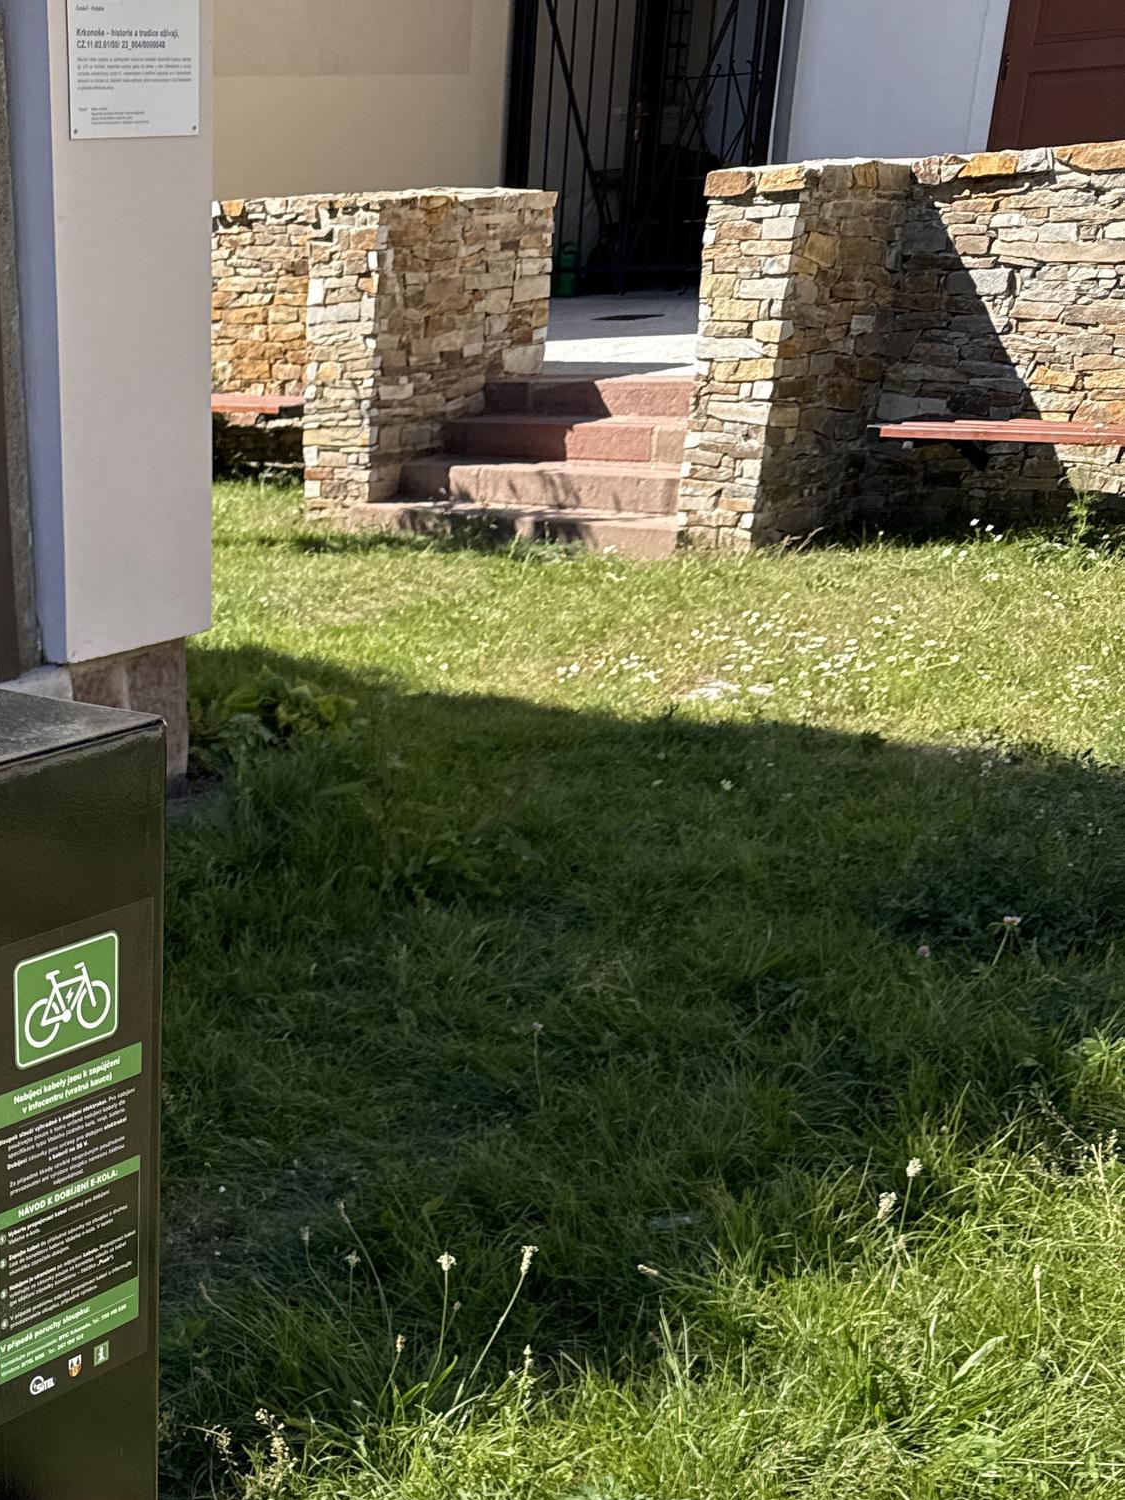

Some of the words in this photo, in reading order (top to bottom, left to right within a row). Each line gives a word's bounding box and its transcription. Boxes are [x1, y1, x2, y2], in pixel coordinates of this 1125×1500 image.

[76, 28, 105, 37] Krkonoše
[111, 28, 133, 37] historie
[139, 29, 159, 37] tradice
[14, 1088, 42, 1104] Nabíjecí
[43, 1079, 66, 1093] kabely
[67, 1073, 82, 1086] jsou
[89, 1058, 120, 1075] zapůjčení
[28, 1092, 64, 1111] infocentru
[65, 1081, 89, 1098] (vratná
[90, 1072, 112, 1087] kauce)
[18, 1200, 46, 1217] NÁVOD
[48, 1196, 52, 1205] K
[55, 1180, 89, 1202] DOBÍJENÍ
[91, 1170, 118, 1187] E-KOLA:
[7, 1332, 33, 1352] případě
[34, 1320, 61, 1339] poruchy
